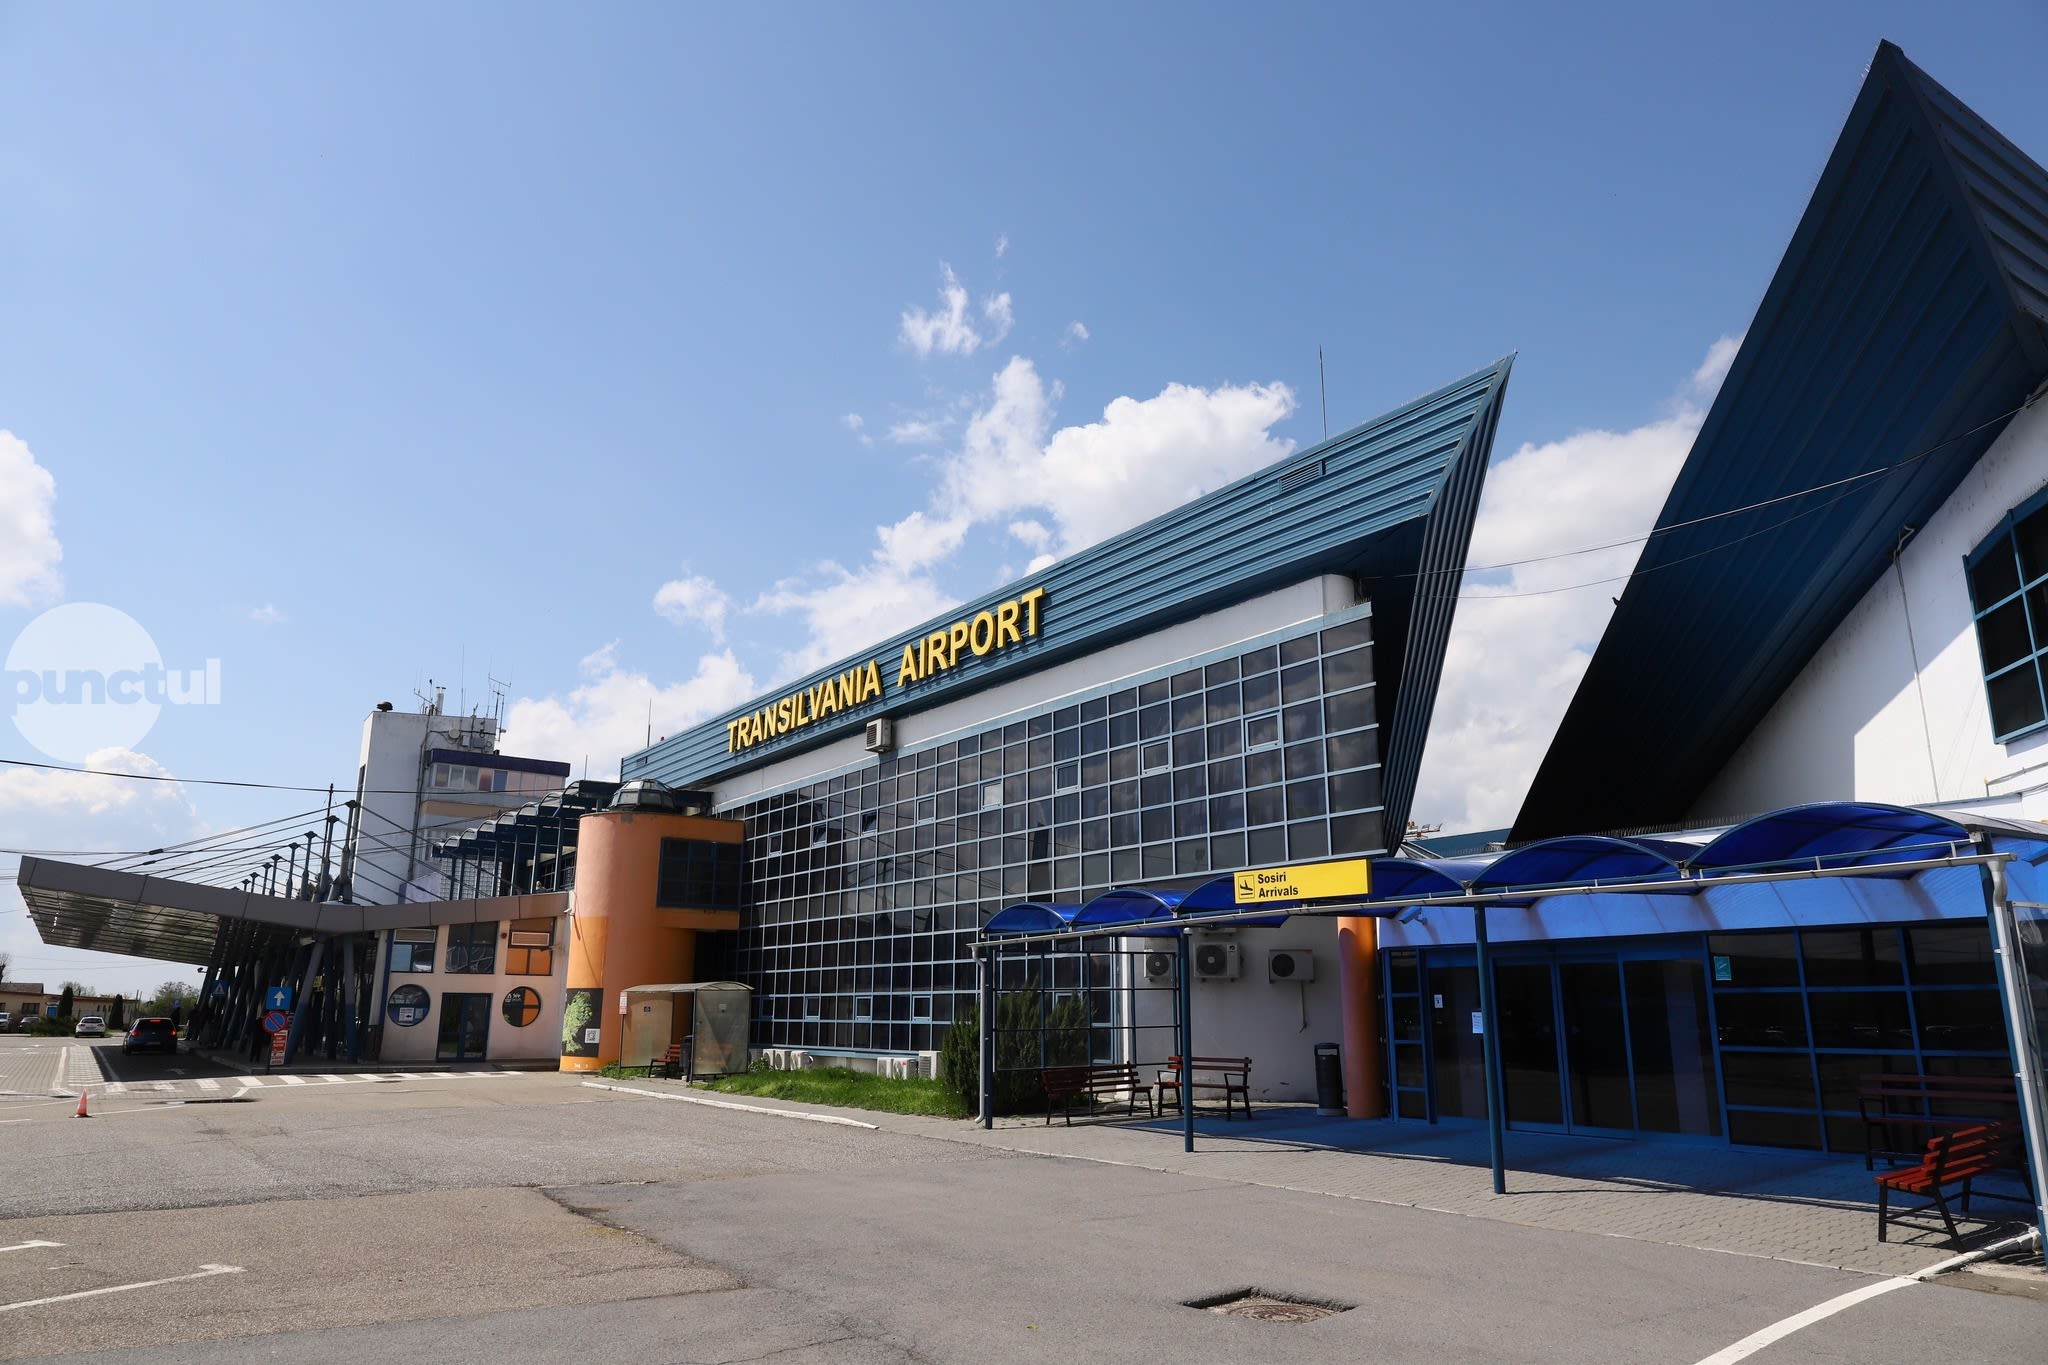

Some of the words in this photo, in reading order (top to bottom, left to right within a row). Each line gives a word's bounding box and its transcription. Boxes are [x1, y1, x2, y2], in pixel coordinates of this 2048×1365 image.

[726, 660, 882, 754] TRANSILVANIA
[897, 587, 1046, 687] AIRPORT
[1257, 872, 1286, 884] Sosiri
[1258, 885, 1299, 898] Arrivals
